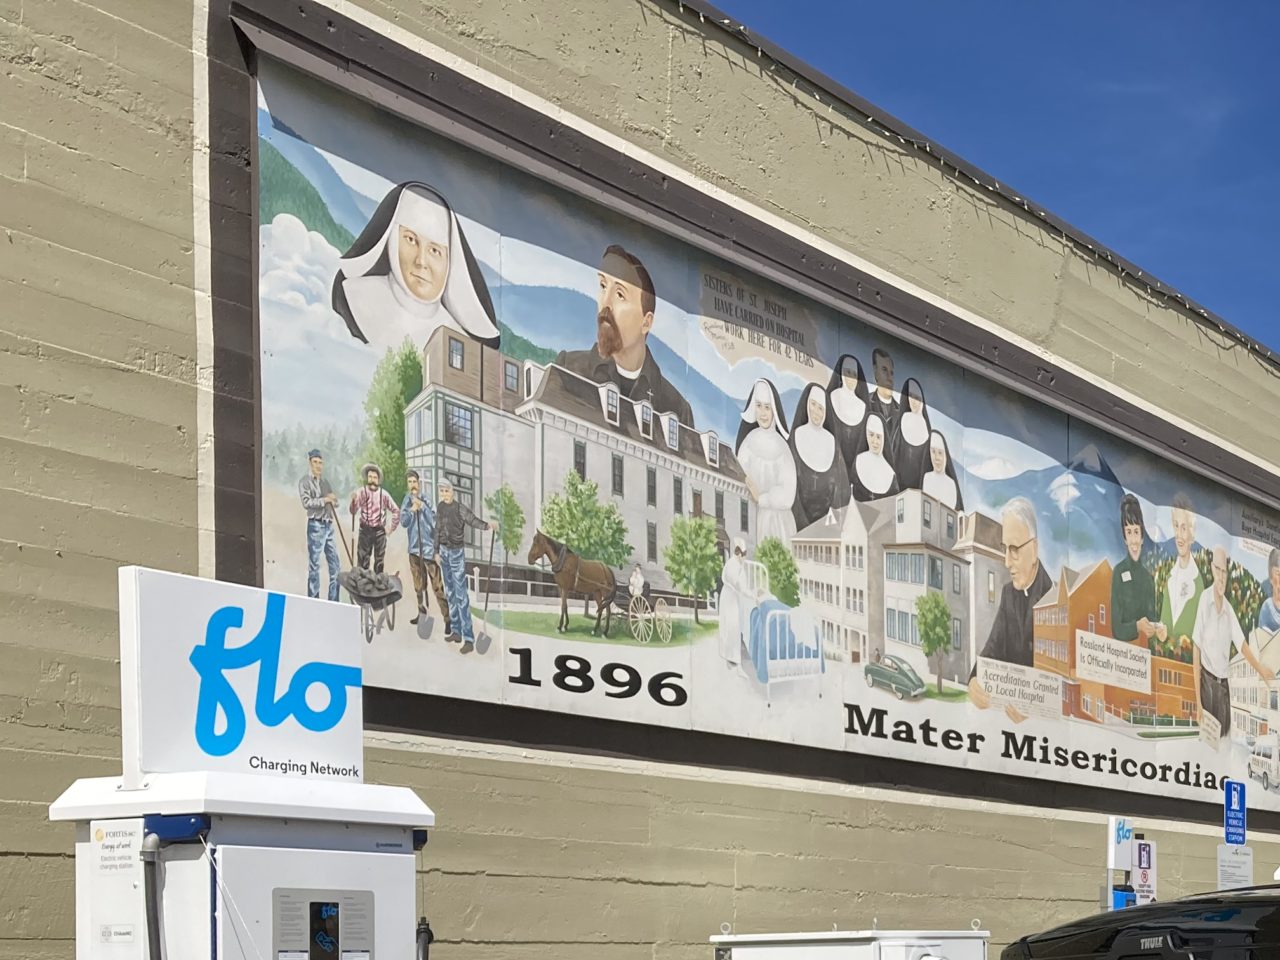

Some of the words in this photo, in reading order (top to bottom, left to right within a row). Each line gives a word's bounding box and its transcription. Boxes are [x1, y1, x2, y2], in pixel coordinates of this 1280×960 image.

[703, 273, 733, 297] SISTERS
[737, 287, 744, 302] OF
[764, 299, 787, 320] JOSEPH
[714, 296, 733, 316] HAVE
[735, 305, 764, 329] CARRIED
[765, 319, 774, 334] ON
[776, 323, 805, 346] HOSPITAL
[724, 320, 744, 341] WORK
[748, 327, 765, 349] HERE
[769, 338, 782, 355] FOR
[785, 345, 792, 359] 42
[794, 350, 815, 368] YEARS
[1080, 636, 1106, 653] Rossland
[1106, 643, 1128, 660] Hospital
[1129, 650, 1147, 665] Society
[189, 592, 362, 757] flo
[508, 647, 688, 707] 1896
[1080, 652, 1085, 663] Is
[1087, 655, 1113, 672] Officially
[1115, 660, 1147, 680] Incorporated
[982, 669, 1031, 688] Accreditation
[1033, 680, 1059, 696] Granted
[984, 682, 993, 694] To
[996, 684, 1016, 699] Local
[1018, 689, 1045, 705] Hospital
[843, 703, 985, 754] Mater
[249, 756, 307, 775] Charging
[310, 761, 359, 778] Network
[1117, 819, 1132, 844] flo
[1140, 936, 1164, 951] THULE
